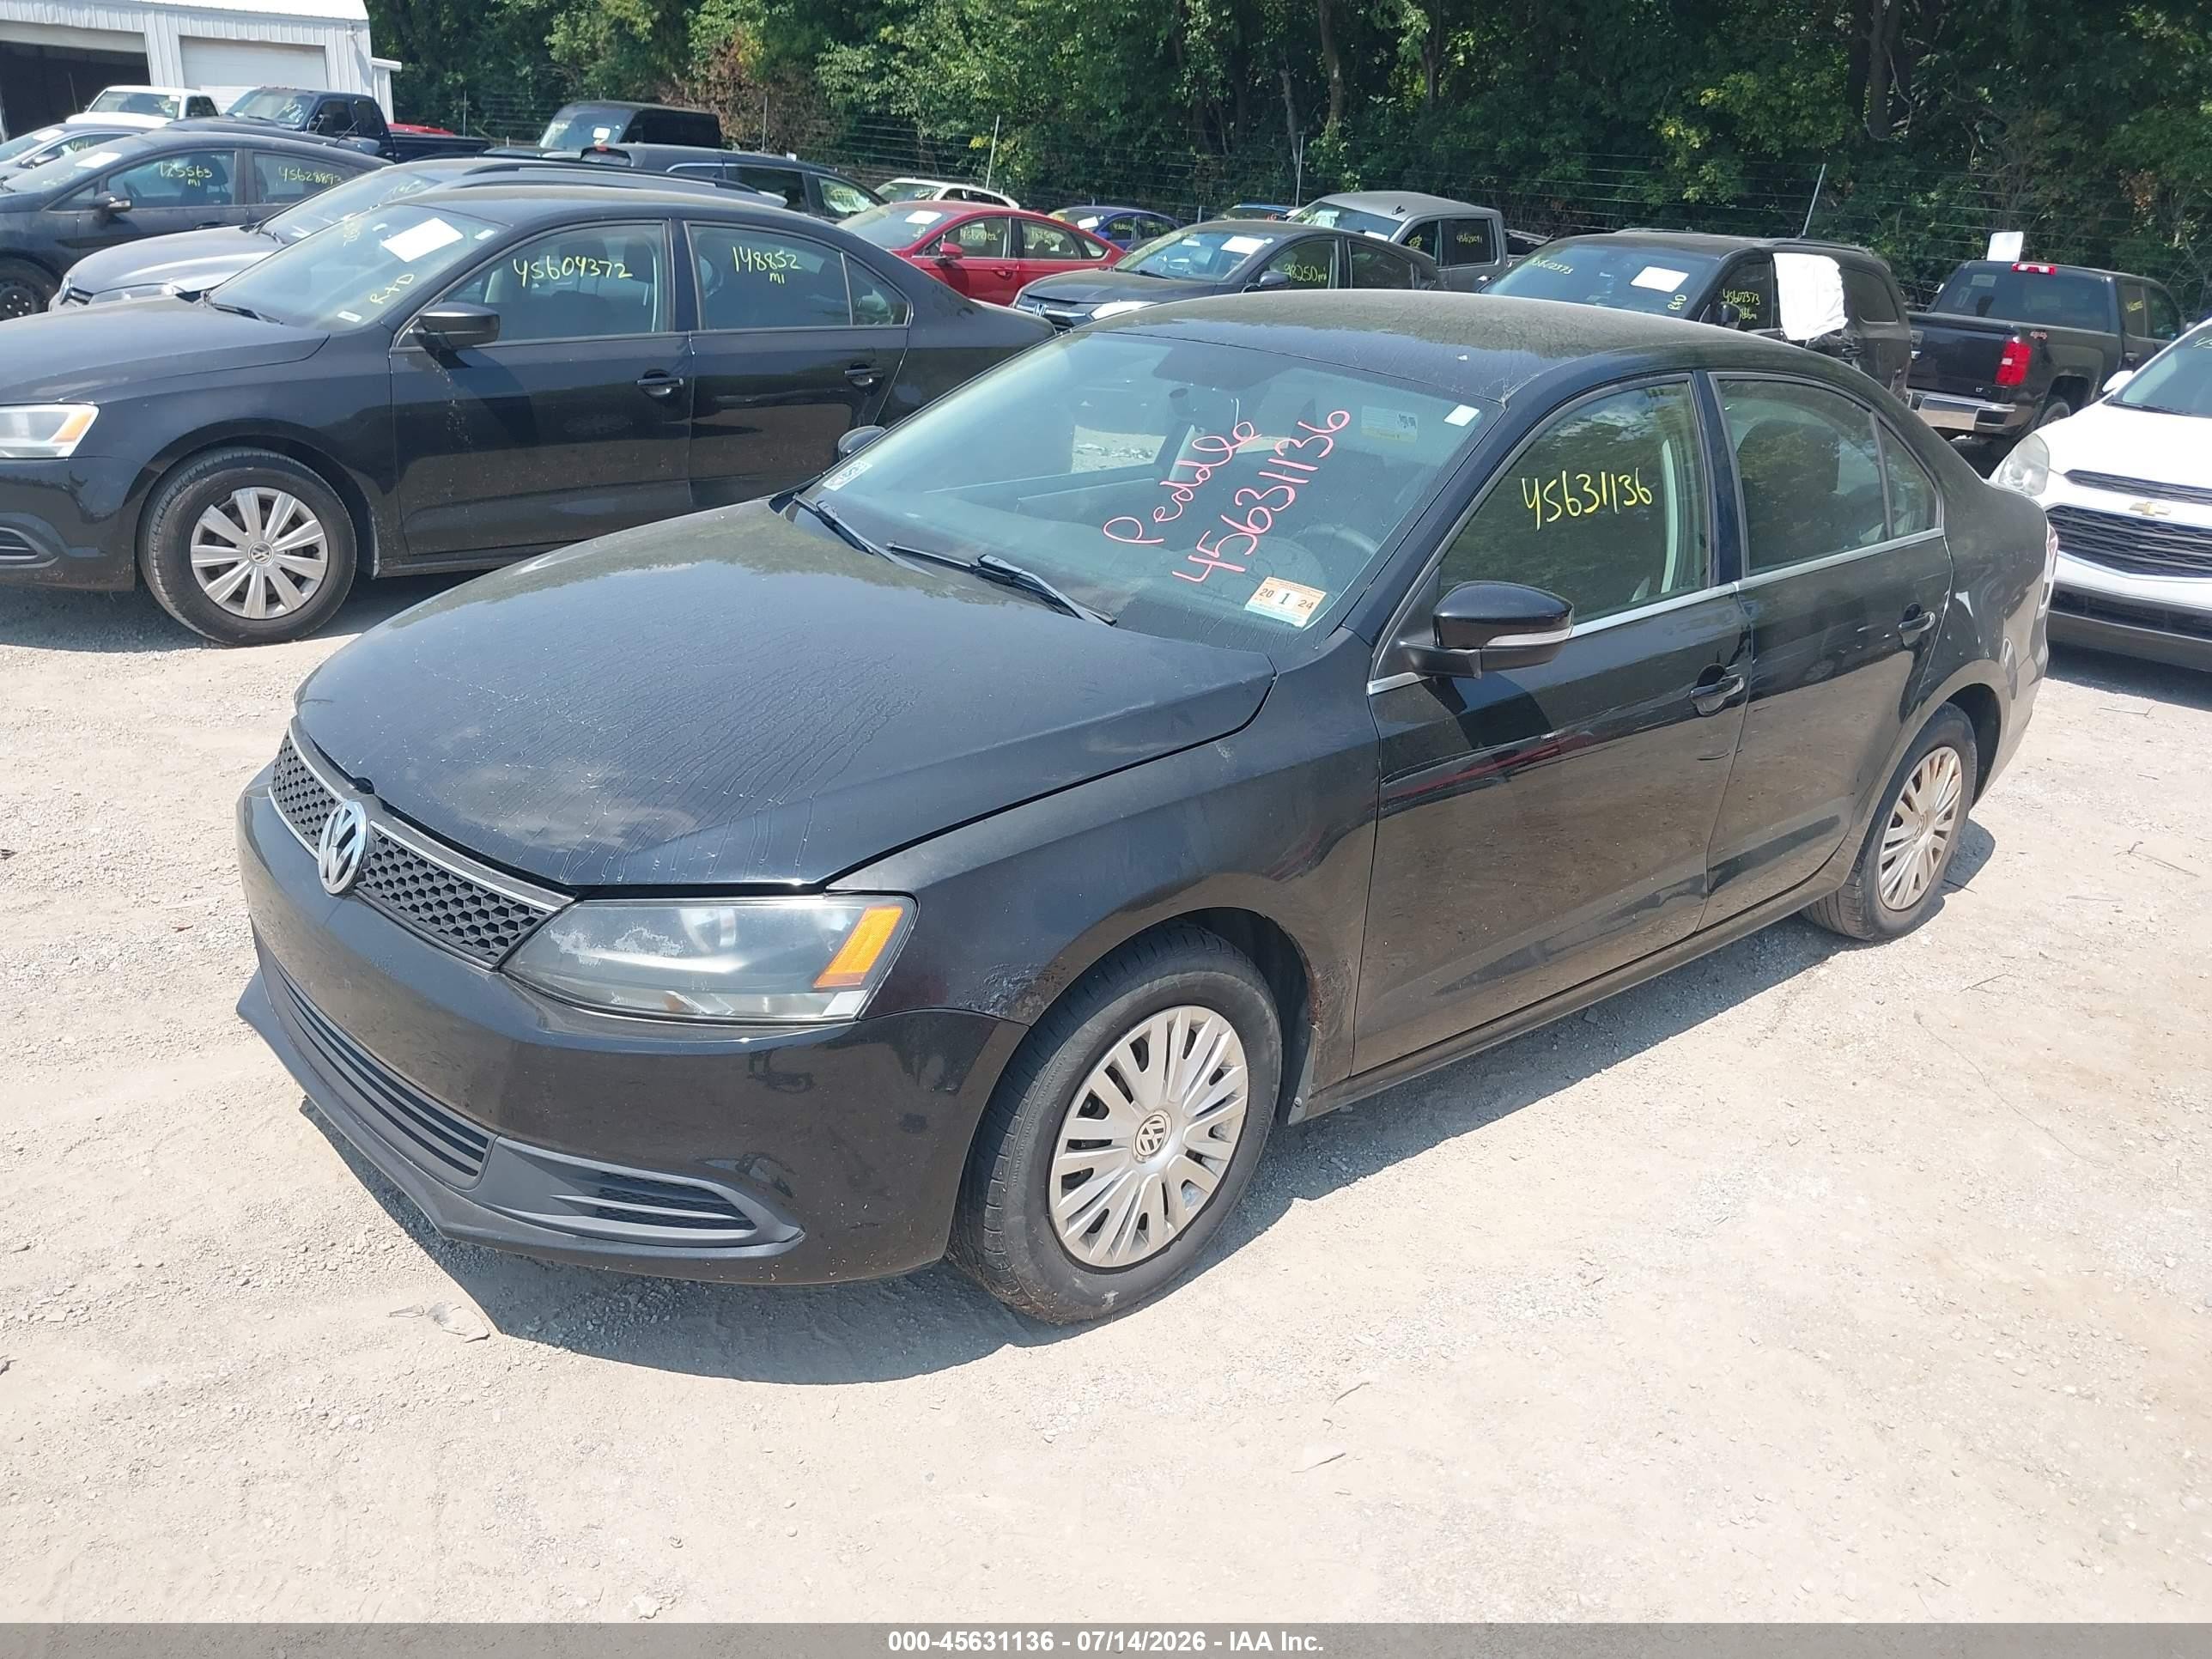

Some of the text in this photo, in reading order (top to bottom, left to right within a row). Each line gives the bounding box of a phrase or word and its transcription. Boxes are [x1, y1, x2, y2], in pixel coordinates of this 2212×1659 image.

[513, 255, 633, 288] 45604372
[732, 246, 803, 272] 148852
[1171, 410, 1351, 583] 45631136
[1521, 467, 1653, 531] 45631136
[1259, 587, 1275, 599] 20
[1278, 592, 1291, 605] 1
[1297, 599, 1315, 610] 24
